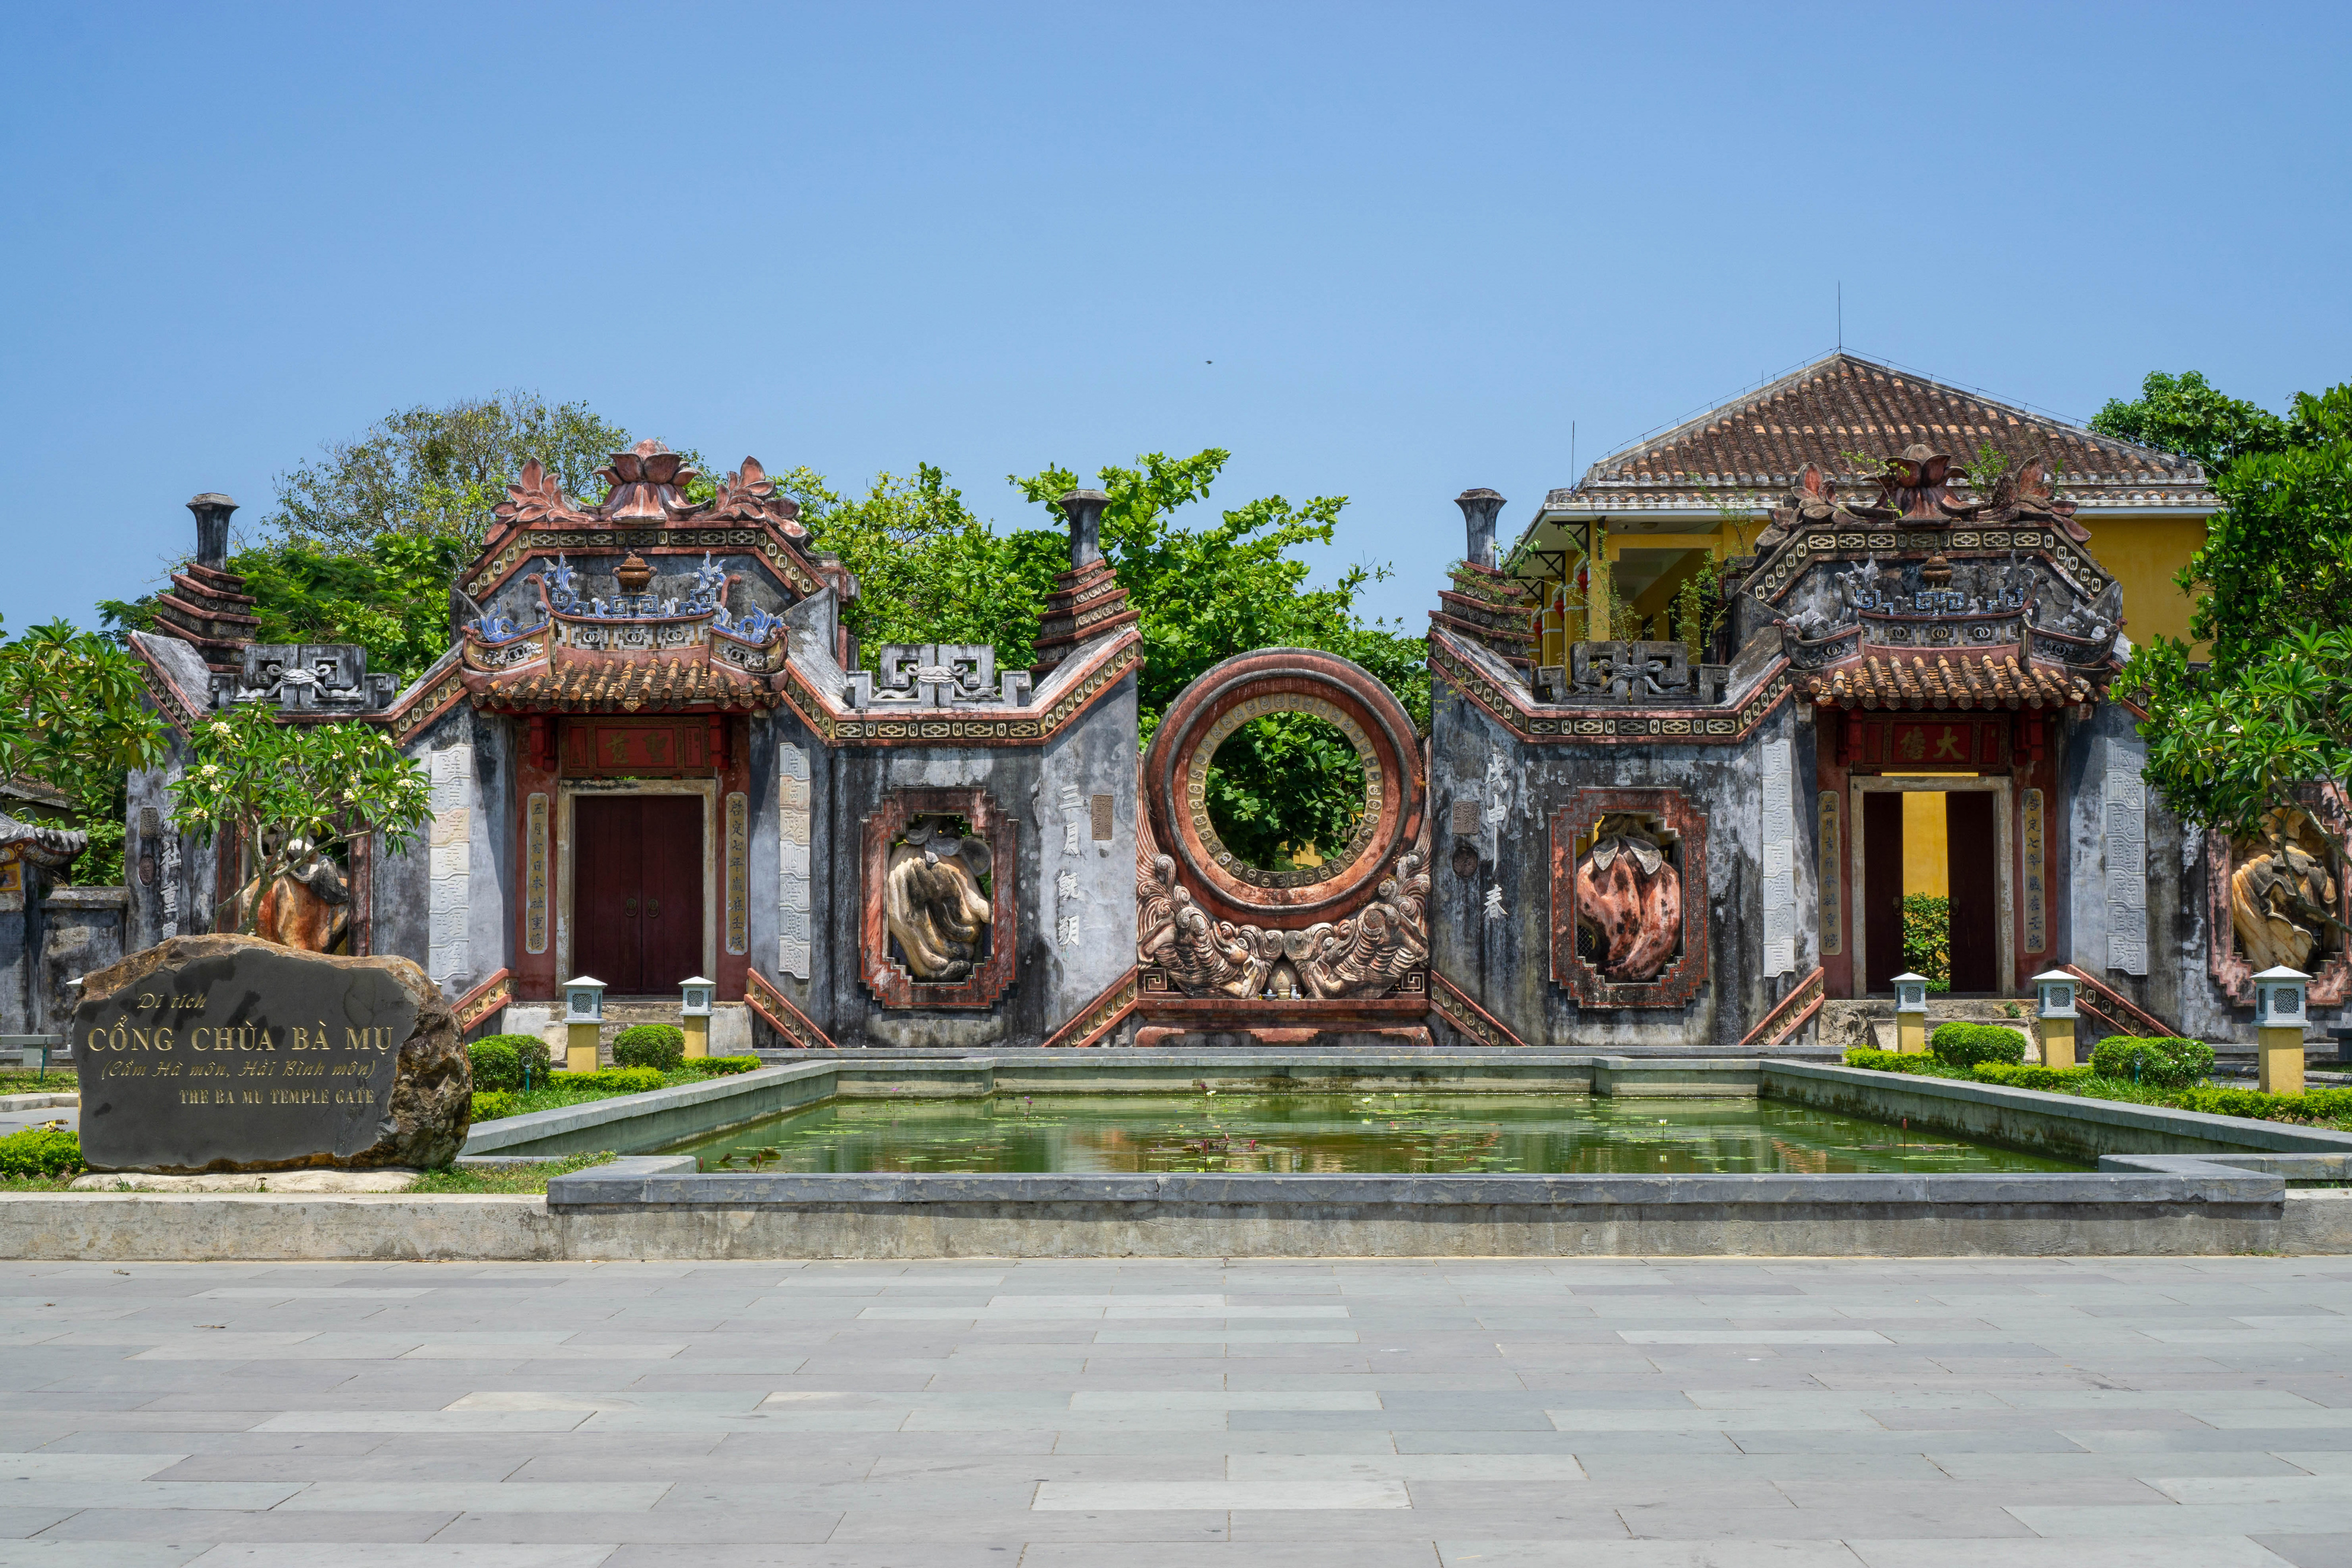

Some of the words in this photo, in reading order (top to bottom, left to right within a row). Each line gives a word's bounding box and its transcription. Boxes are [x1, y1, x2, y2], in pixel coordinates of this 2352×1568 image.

[1898, 726, 1965, 760] 大德
[137, 993, 165, 1008] Di
[171, 993, 207, 1008] tích
[88, 1015, 175, 1051] CỔNG
[191, 1020, 275, 1051] CHÙA
[292, 1020, 331, 1050] BÀ
[345, 1027, 393, 1055] MỤ
[151, 1061, 183, 1077] Hà
[189, 1061, 230, 1078] môn,
[282, 1060, 326, 1076] Bình
[331, 1060, 376, 1079] môn)
[179, 1090, 208, 1104] THE
[215, 1090, 235, 1104] BA
[242, 1090, 263, 1104] MU
[270, 1088, 329, 1105] TEMPLE
[336, 1088, 374, 1105] GATE
